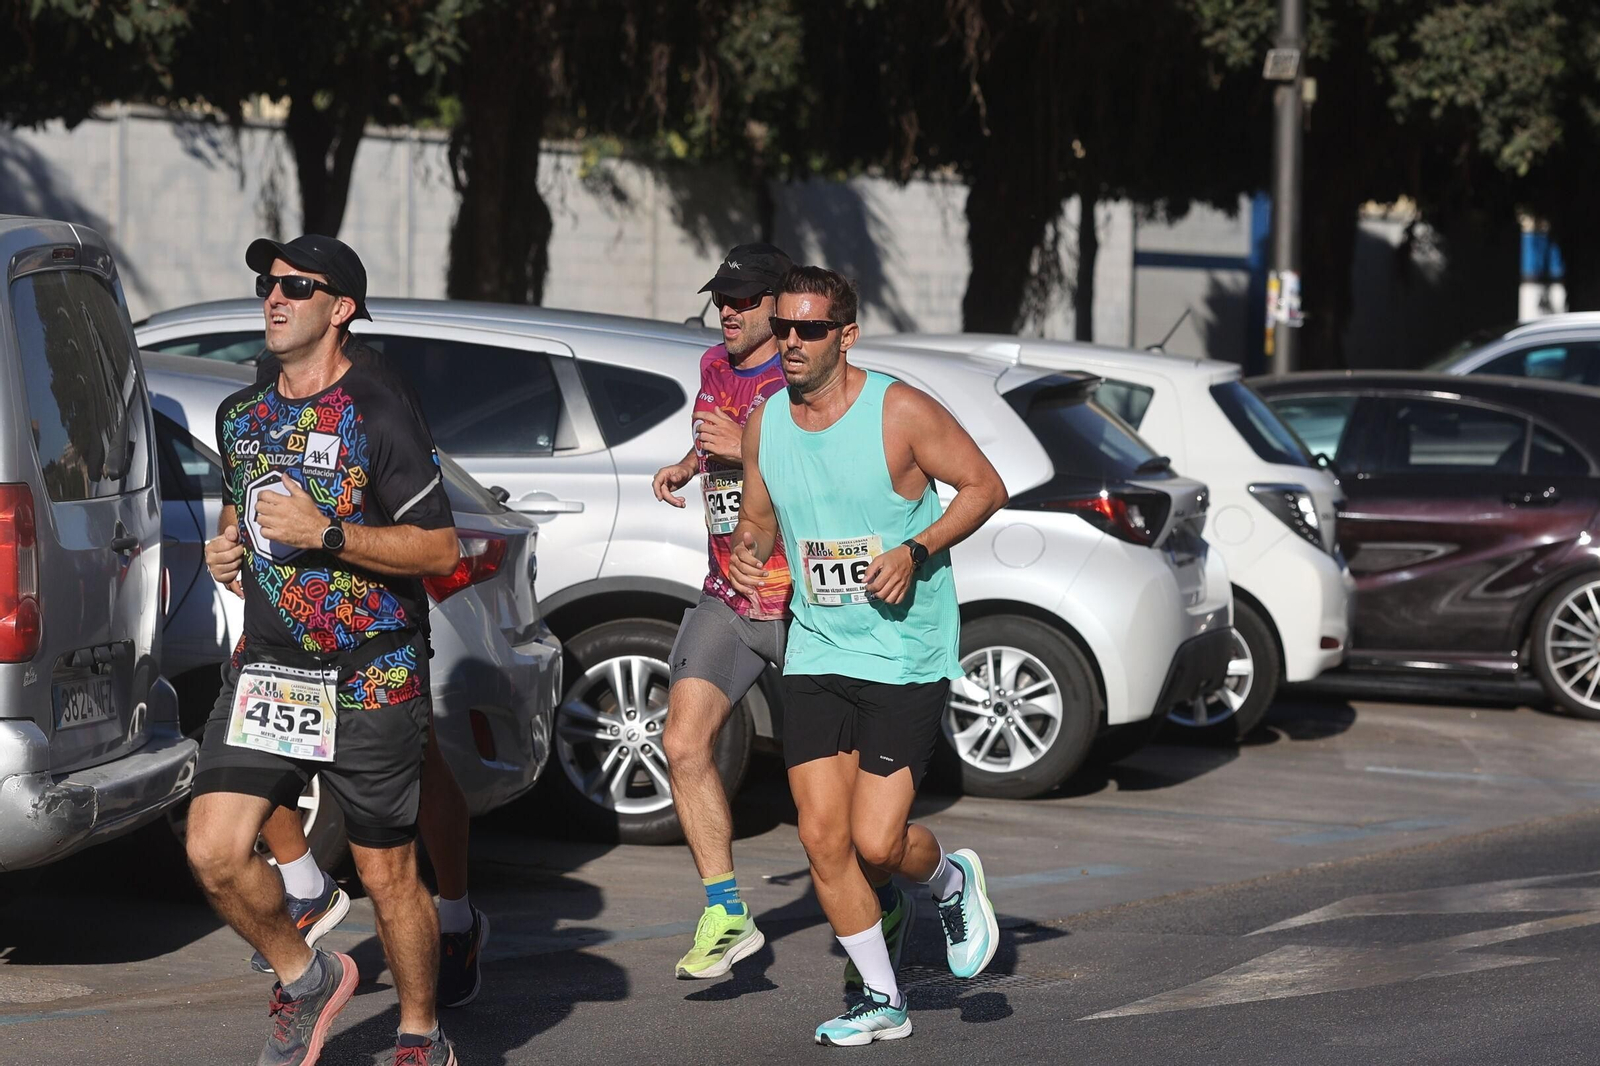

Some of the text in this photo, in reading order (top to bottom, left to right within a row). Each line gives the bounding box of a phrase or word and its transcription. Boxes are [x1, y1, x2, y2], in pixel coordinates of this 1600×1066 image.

[305, 450, 330, 466] AXA
[303, 467, 335, 478] fundación
[707, 491, 742, 515] 343
[806, 541, 825, 557] XII
[838, 545, 868, 556] 2025
[812, 561, 869, 585] 116
[249, 680, 278, 696] XII
[61, 682, 94, 723] 3824
[289, 692, 320, 704] 2025
[245, 701, 321, 736] 452
